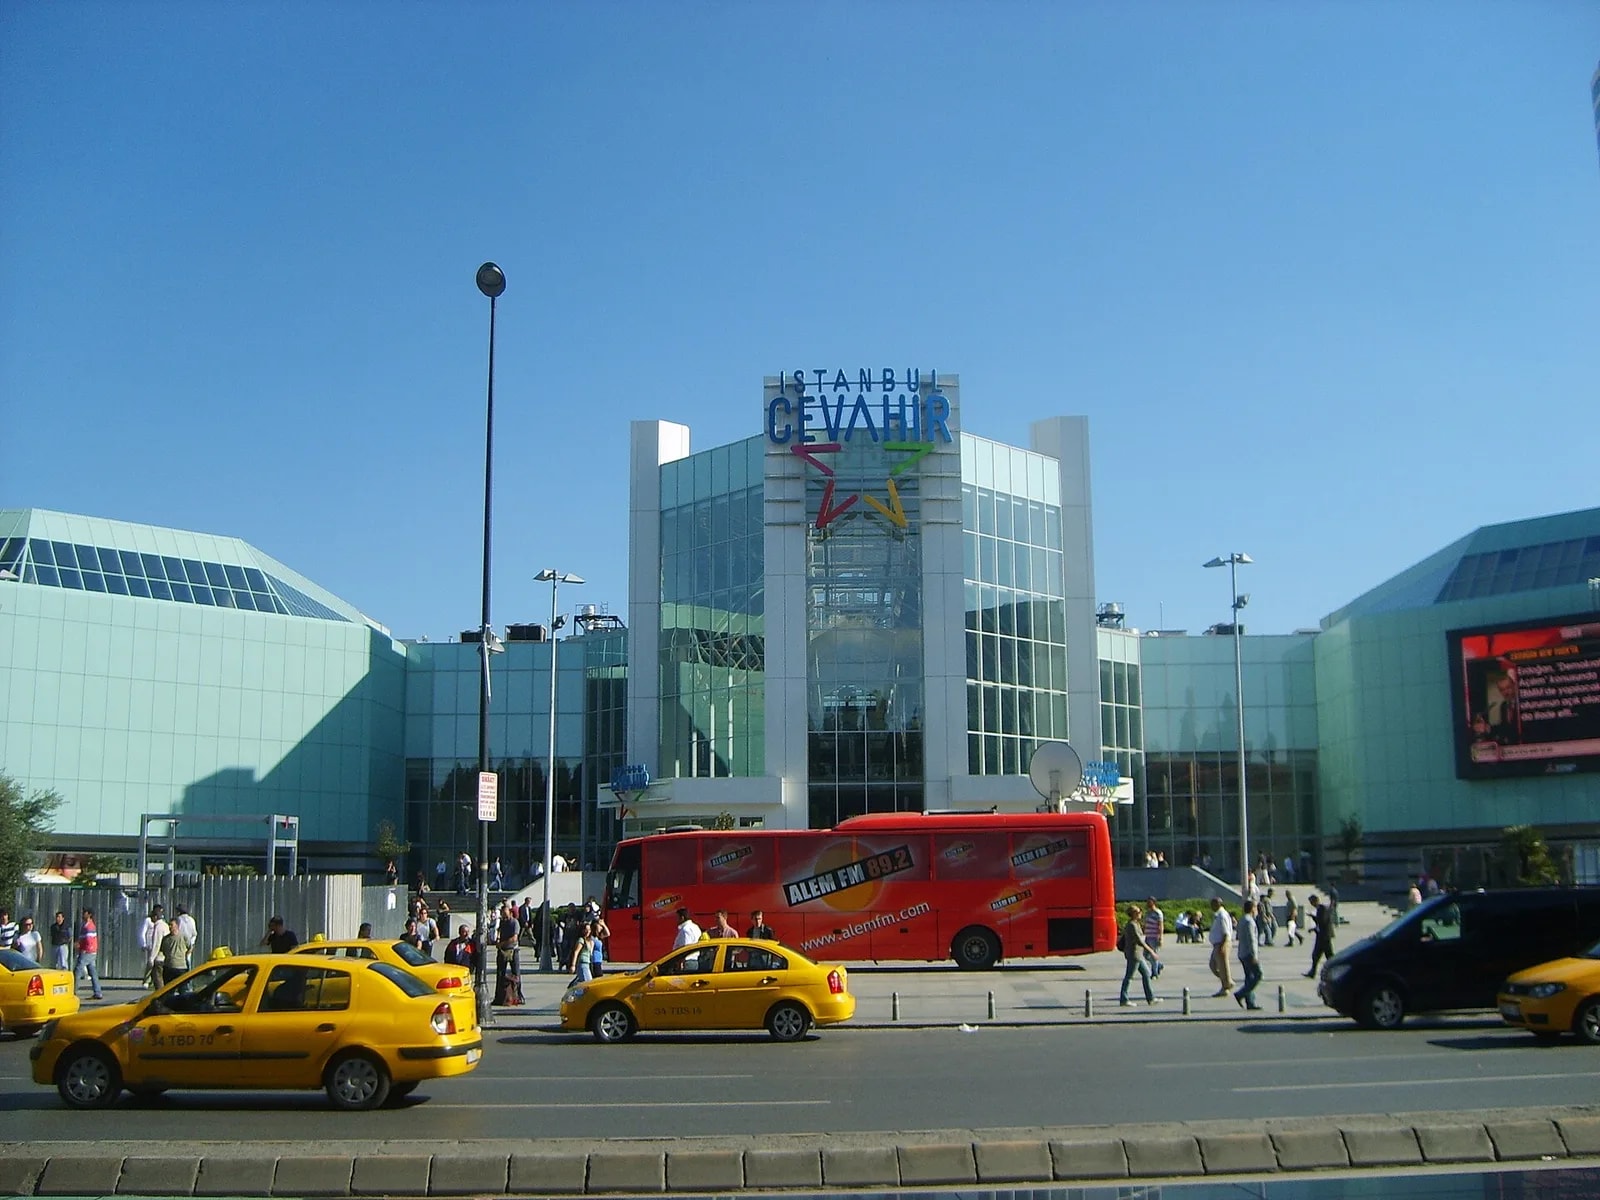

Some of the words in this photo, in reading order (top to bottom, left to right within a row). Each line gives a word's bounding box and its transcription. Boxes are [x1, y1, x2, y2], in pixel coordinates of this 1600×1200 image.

[780, 368, 943, 394] ISTANBUL
[788, 872, 837, 904] ALEM
[838, 863, 867, 888] FM
[866, 850, 910, 878] 89.2
[800, 902, 930, 951] www.alemfm.com
[200, 1034, 214, 1046] 70
